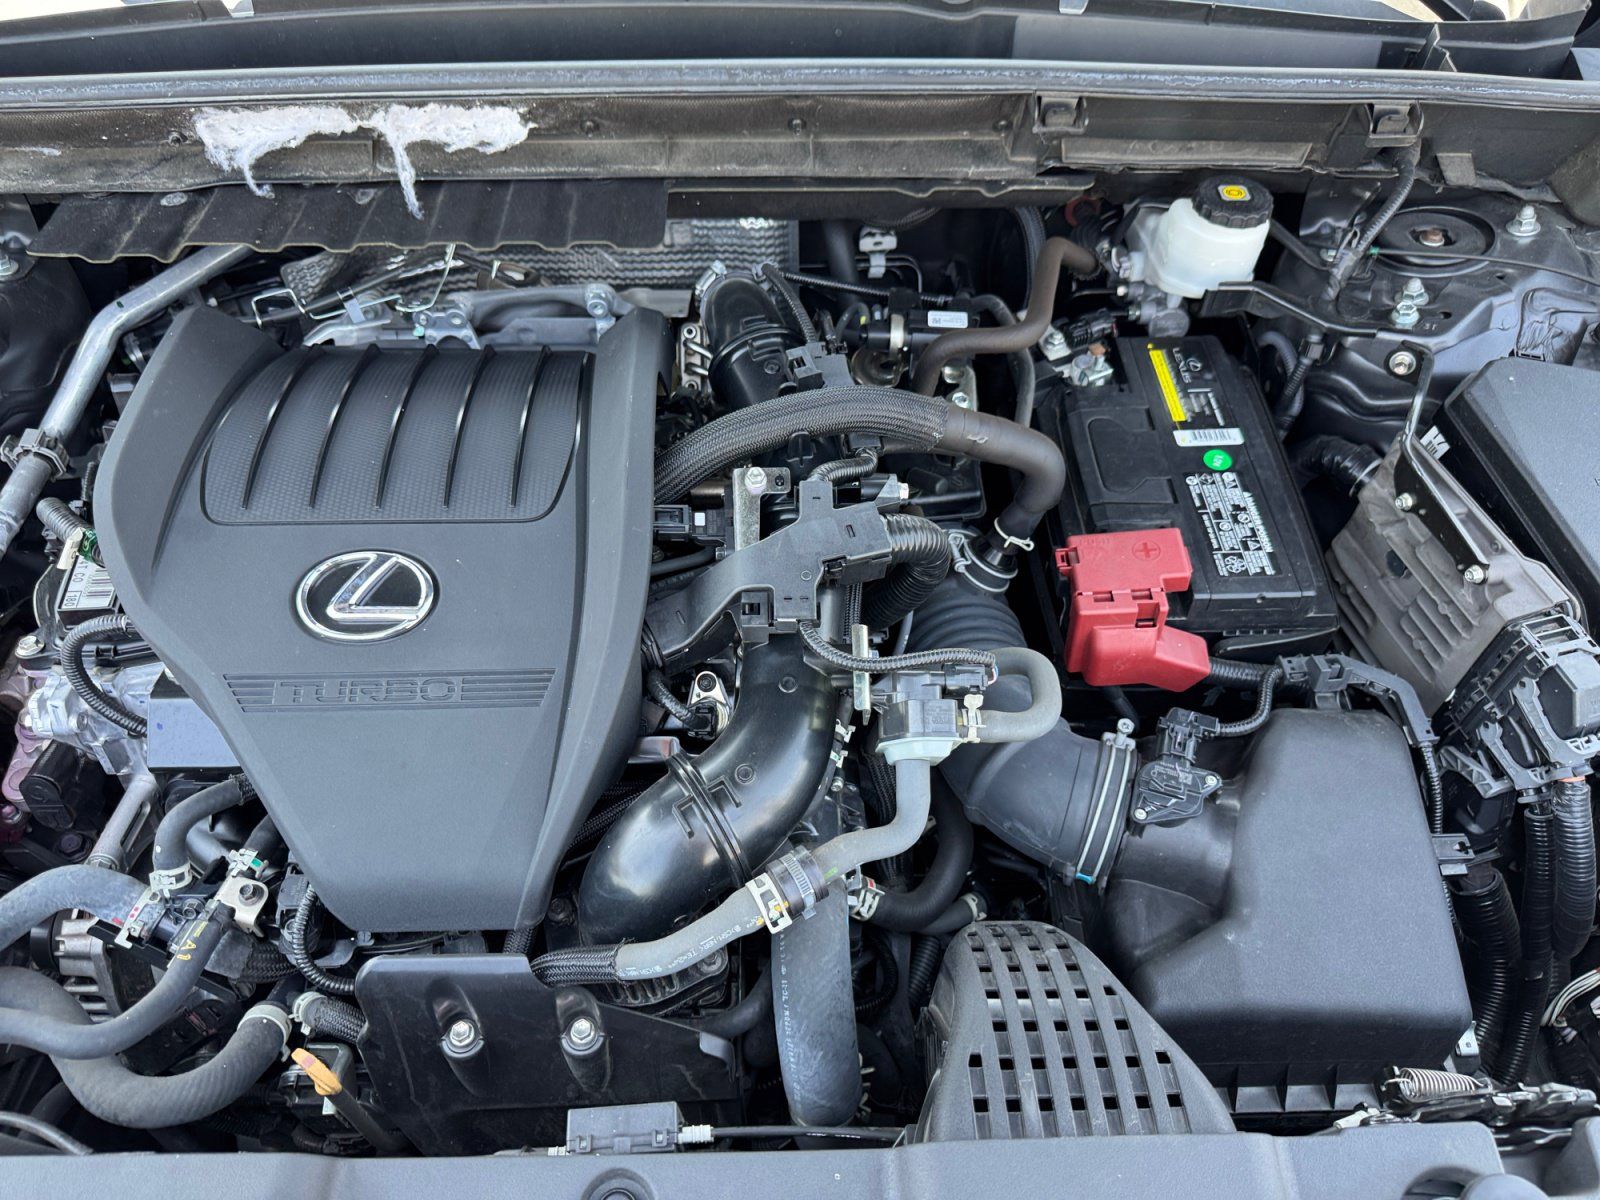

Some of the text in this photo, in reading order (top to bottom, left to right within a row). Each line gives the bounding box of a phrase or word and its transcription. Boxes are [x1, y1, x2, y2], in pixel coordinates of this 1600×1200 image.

[1172, 347, 1192, 384] LEXUS
[1256, 525, 1274, 553] POISON
[64, 594, 78, 607] 180
[279, 678, 457, 704] TURBO
